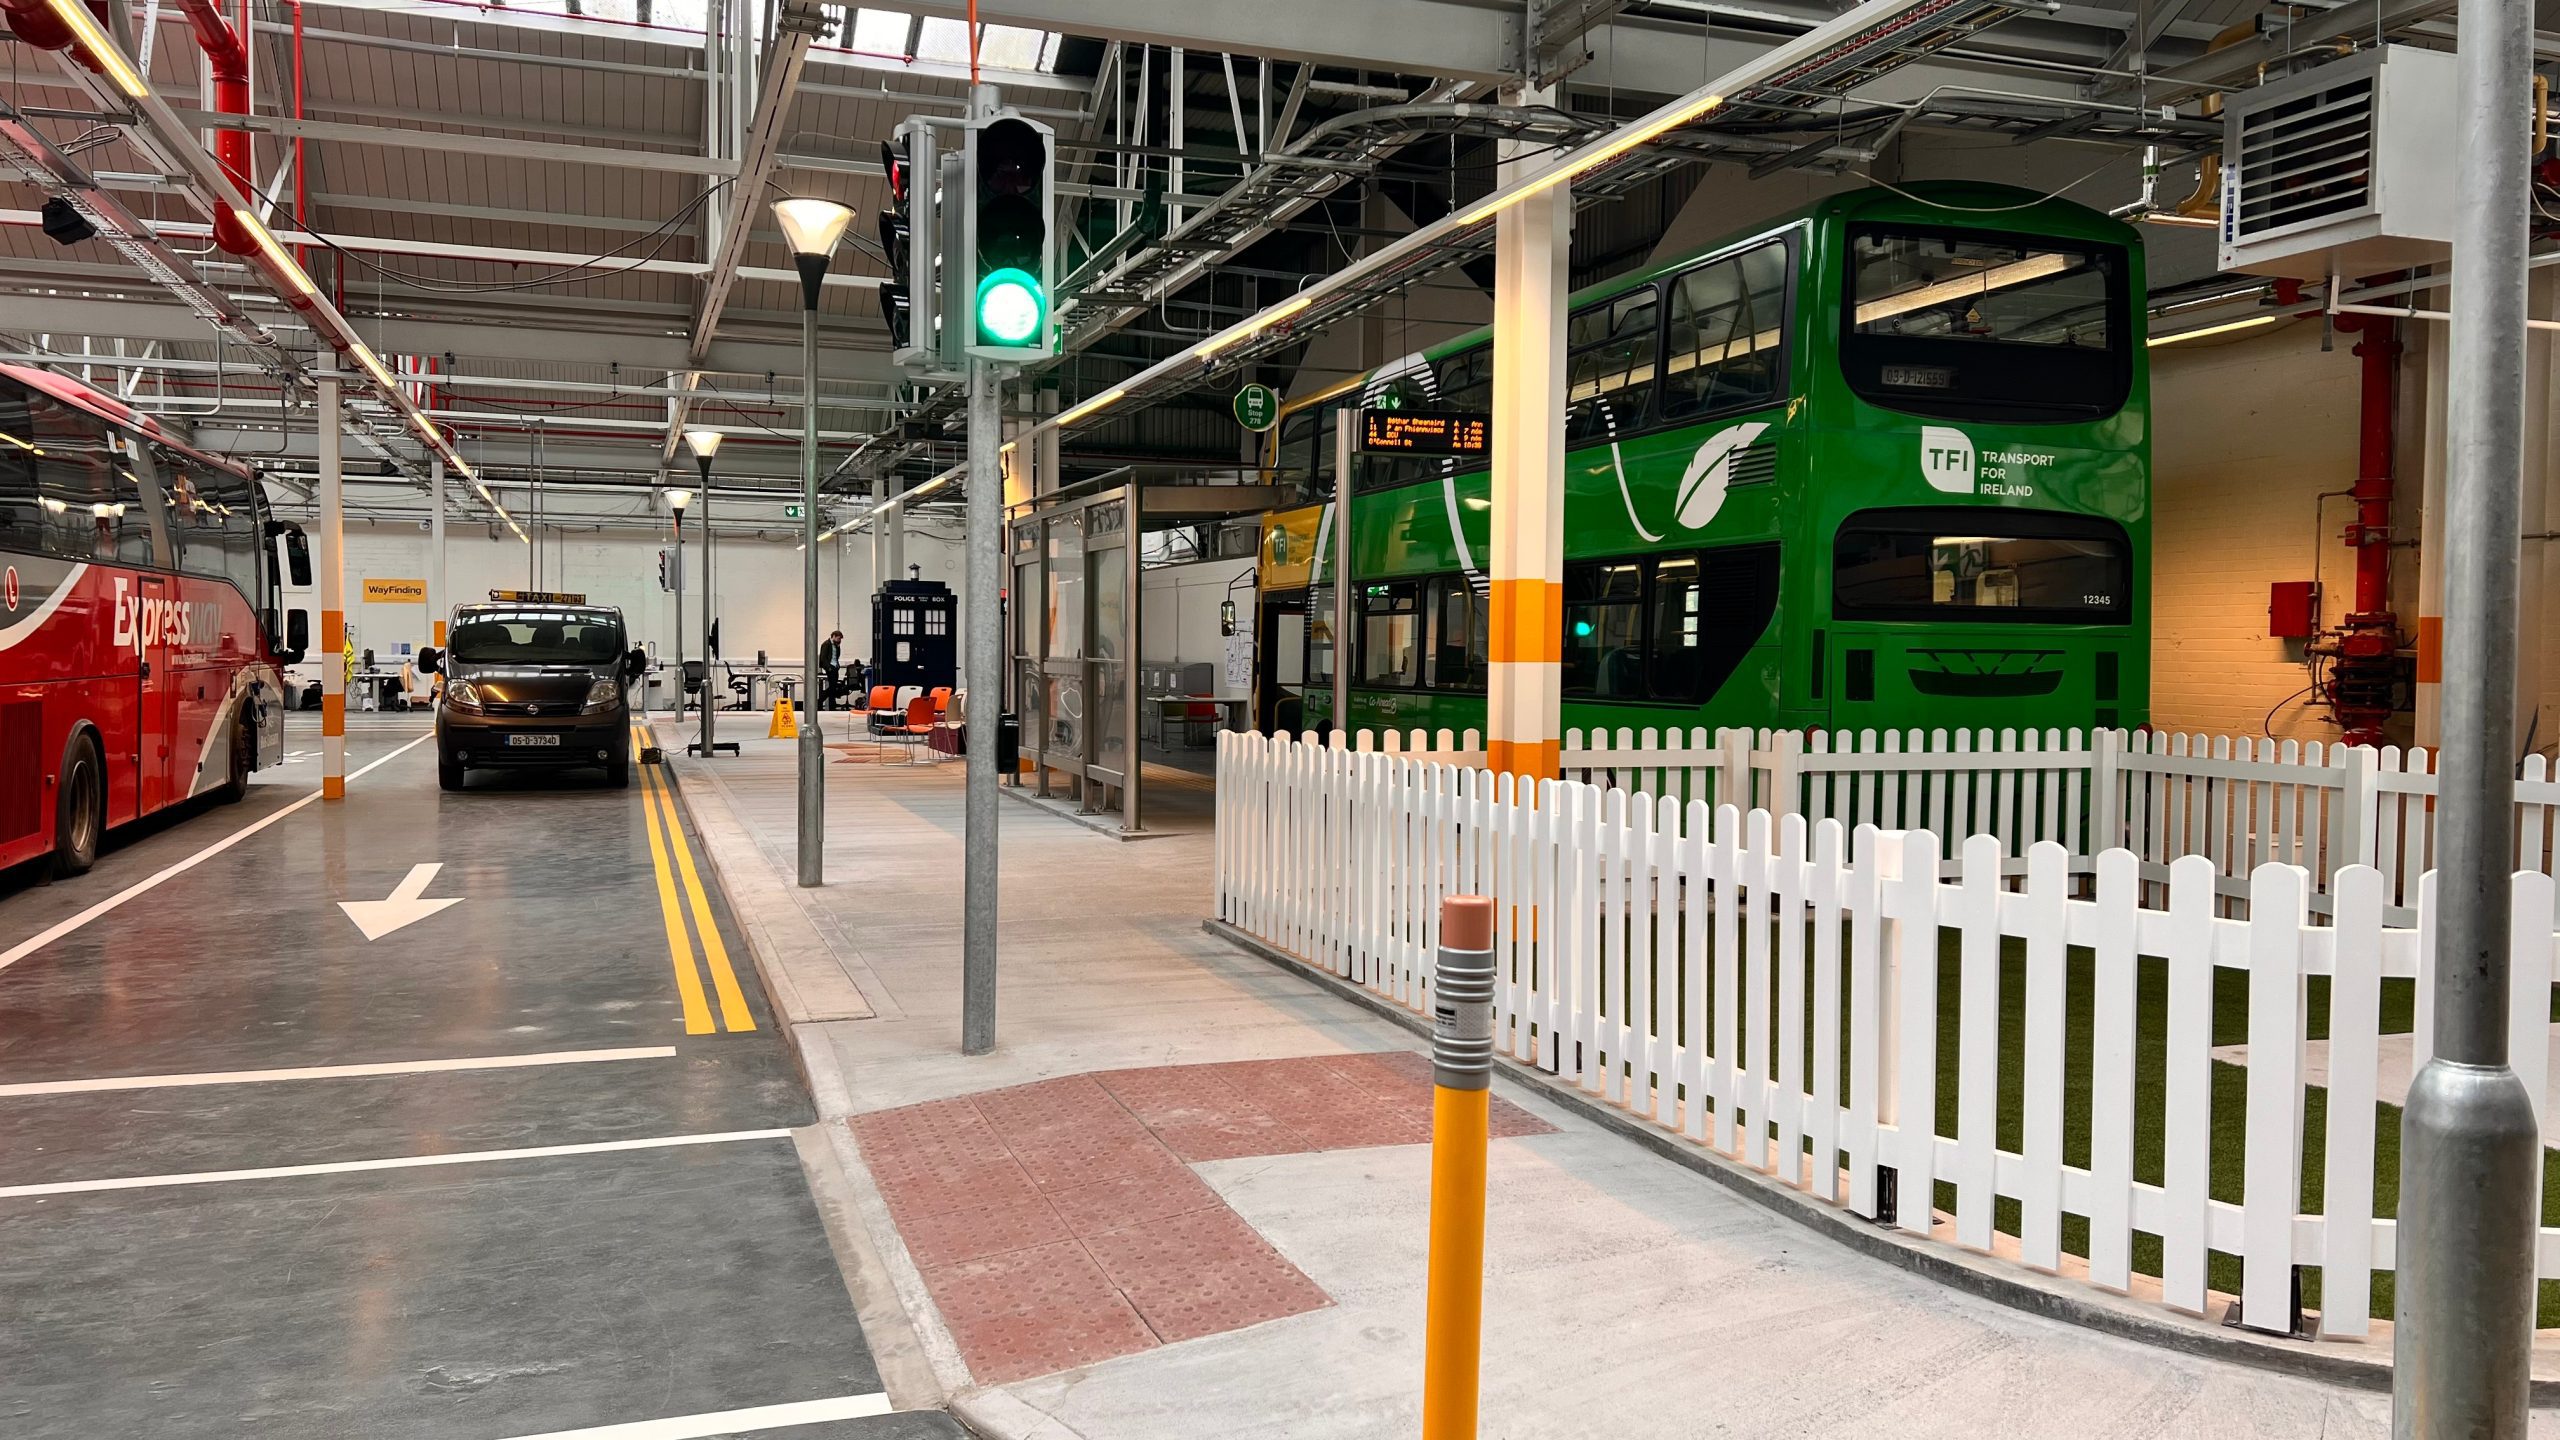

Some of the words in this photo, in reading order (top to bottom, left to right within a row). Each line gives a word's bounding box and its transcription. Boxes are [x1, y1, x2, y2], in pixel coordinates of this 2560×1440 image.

[1247, 409, 1263, 418] Stop
[1929, 448, 1969, 472] TFI
[1982, 451, 2056, 467] TRANSPORT
[1980, 467, 2006, 480] FOR
[1980, 483, 2034, 497] IRELAND
[1274, 537, 1286, 553] TFI
[368, 585, 422, 596] WayFinding
[526, 592, 552, 603] TAXI
[2083, 594, 2111, 605] 12345
[113, 577, 222, 662] Expressway
